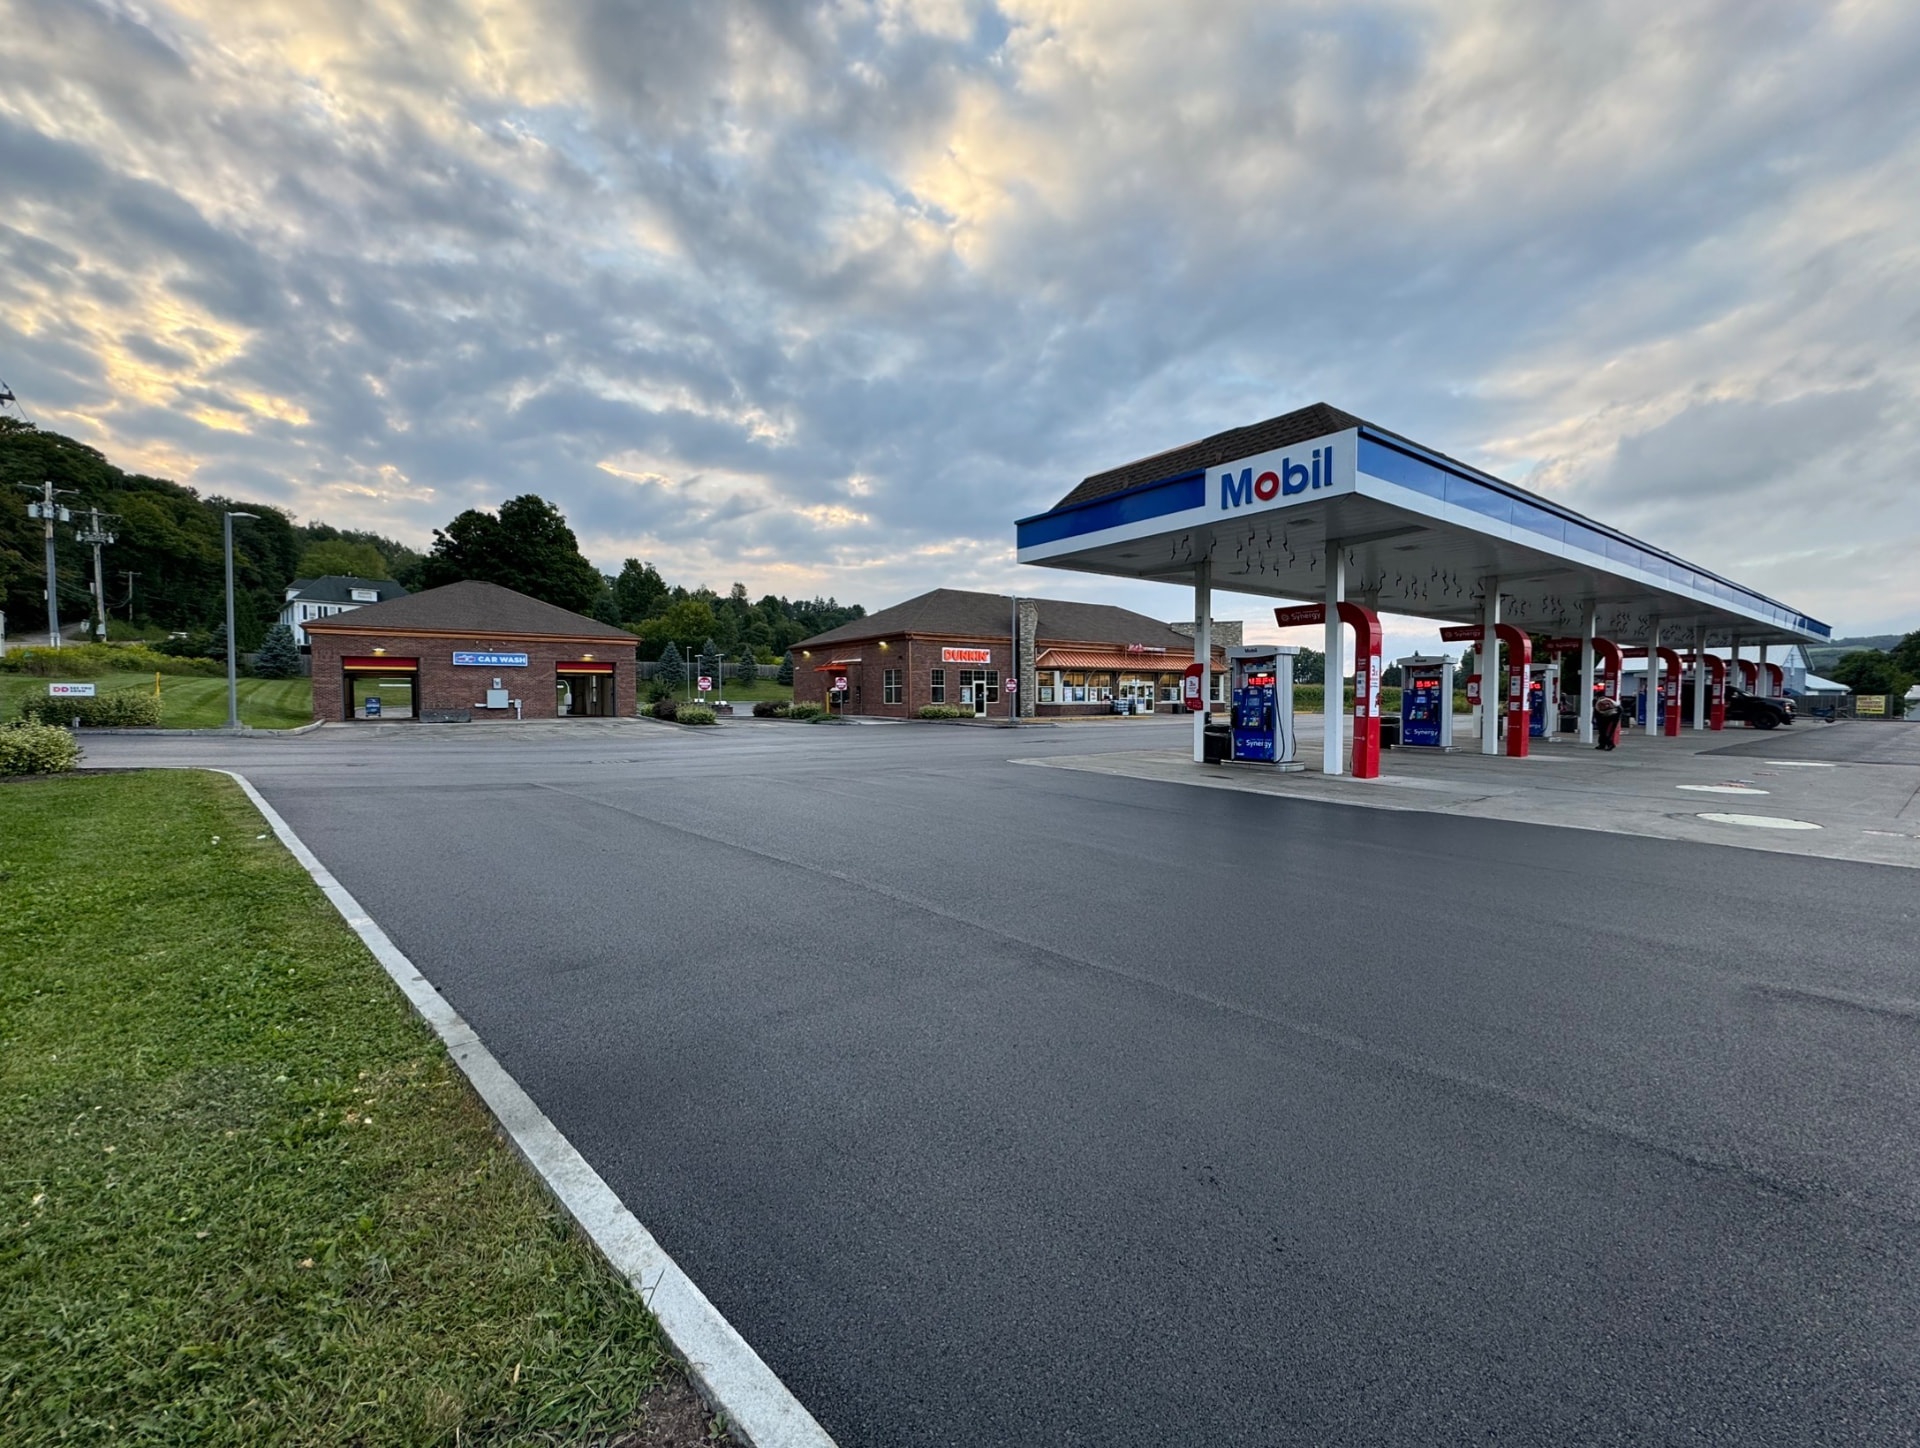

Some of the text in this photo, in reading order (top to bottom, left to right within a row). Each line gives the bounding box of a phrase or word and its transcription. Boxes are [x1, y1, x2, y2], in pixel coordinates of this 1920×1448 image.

[1221, 446, 1333, 510] Mobil
[1290, 612, 1321, 621] Synergy
[944, 649, 989, 662] DUNKIN'
[1245, 739, 1272, 749] Synergy
